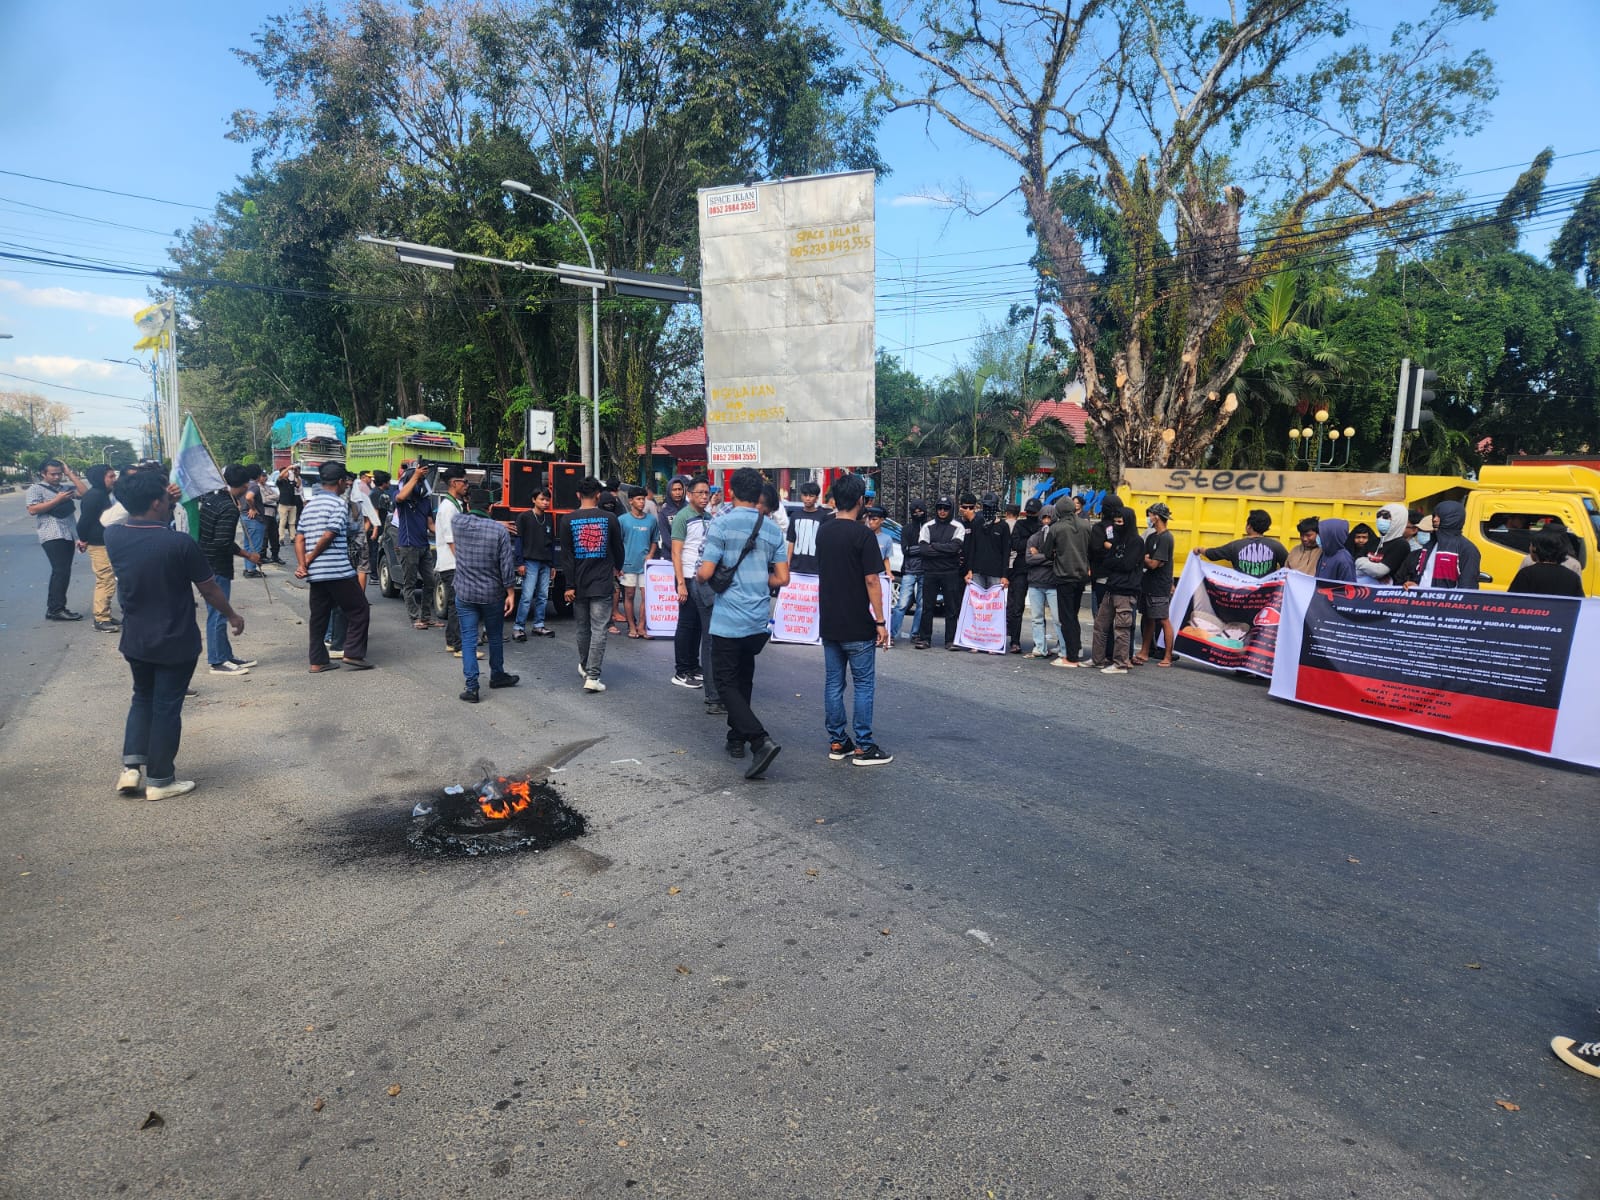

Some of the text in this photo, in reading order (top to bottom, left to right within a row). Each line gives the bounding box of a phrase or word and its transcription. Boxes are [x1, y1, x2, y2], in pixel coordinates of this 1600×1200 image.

[710, 191, 755, 204] SPACE IKLAN
[797, 224, 860, 243] SPACE IKLAN
[713, 443, 756, 452] SPACE IKLAN
[1376, 590, 1417, 599] SERUAN
[1421, 592, 1446, 600] AKSI
[1373, 597, 1550, 616] ALIANSI MASYARAKAT KAB. BARRU
[1399, 619, 1435, 627] PARLEMEN
[1437, 623, 1468, 631] DAERAH
[1445, 617, 1482, 625] HENTIKAN
[1484, 621, 1516, 629] BUDAYA
[1518, 624, 1562, 633] IMPUNITAS
[1402, 694, 1433, 703] AGUSTUS
